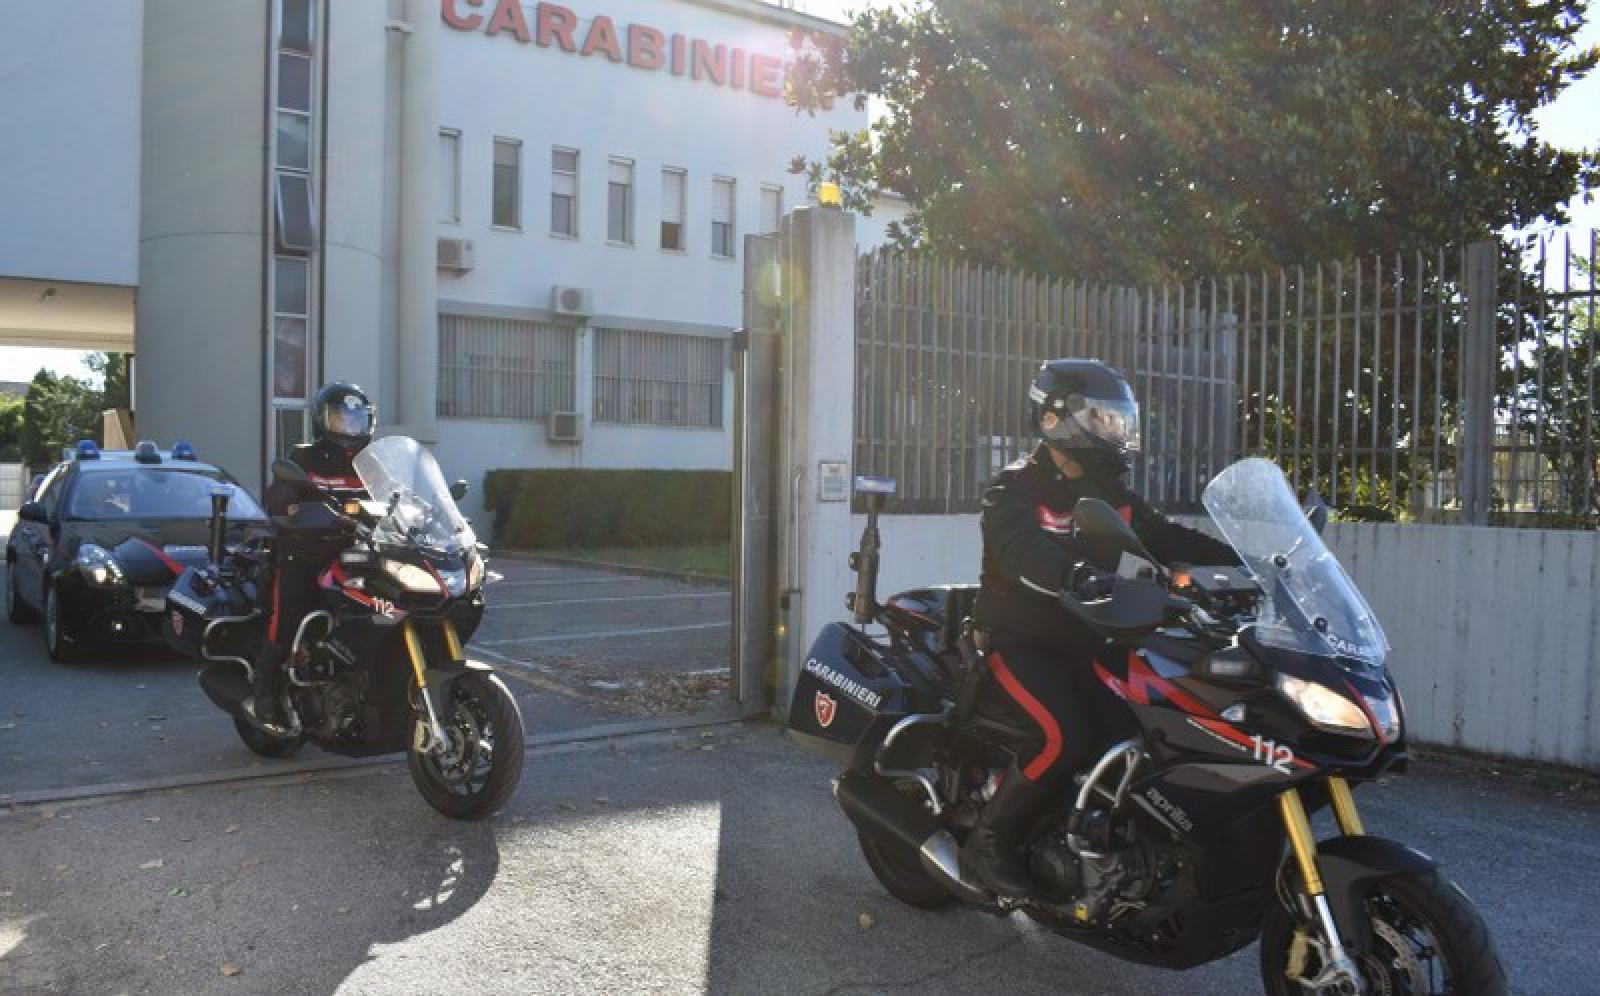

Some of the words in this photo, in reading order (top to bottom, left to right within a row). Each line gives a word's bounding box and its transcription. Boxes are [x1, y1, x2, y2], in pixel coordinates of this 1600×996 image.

[441, 0, 788, 99] CARABINIE
[371, 595, 396, 619] 112
[805, 657, 882, 709] CARABINIERI
[1249, 734, 1295, 776] 112
